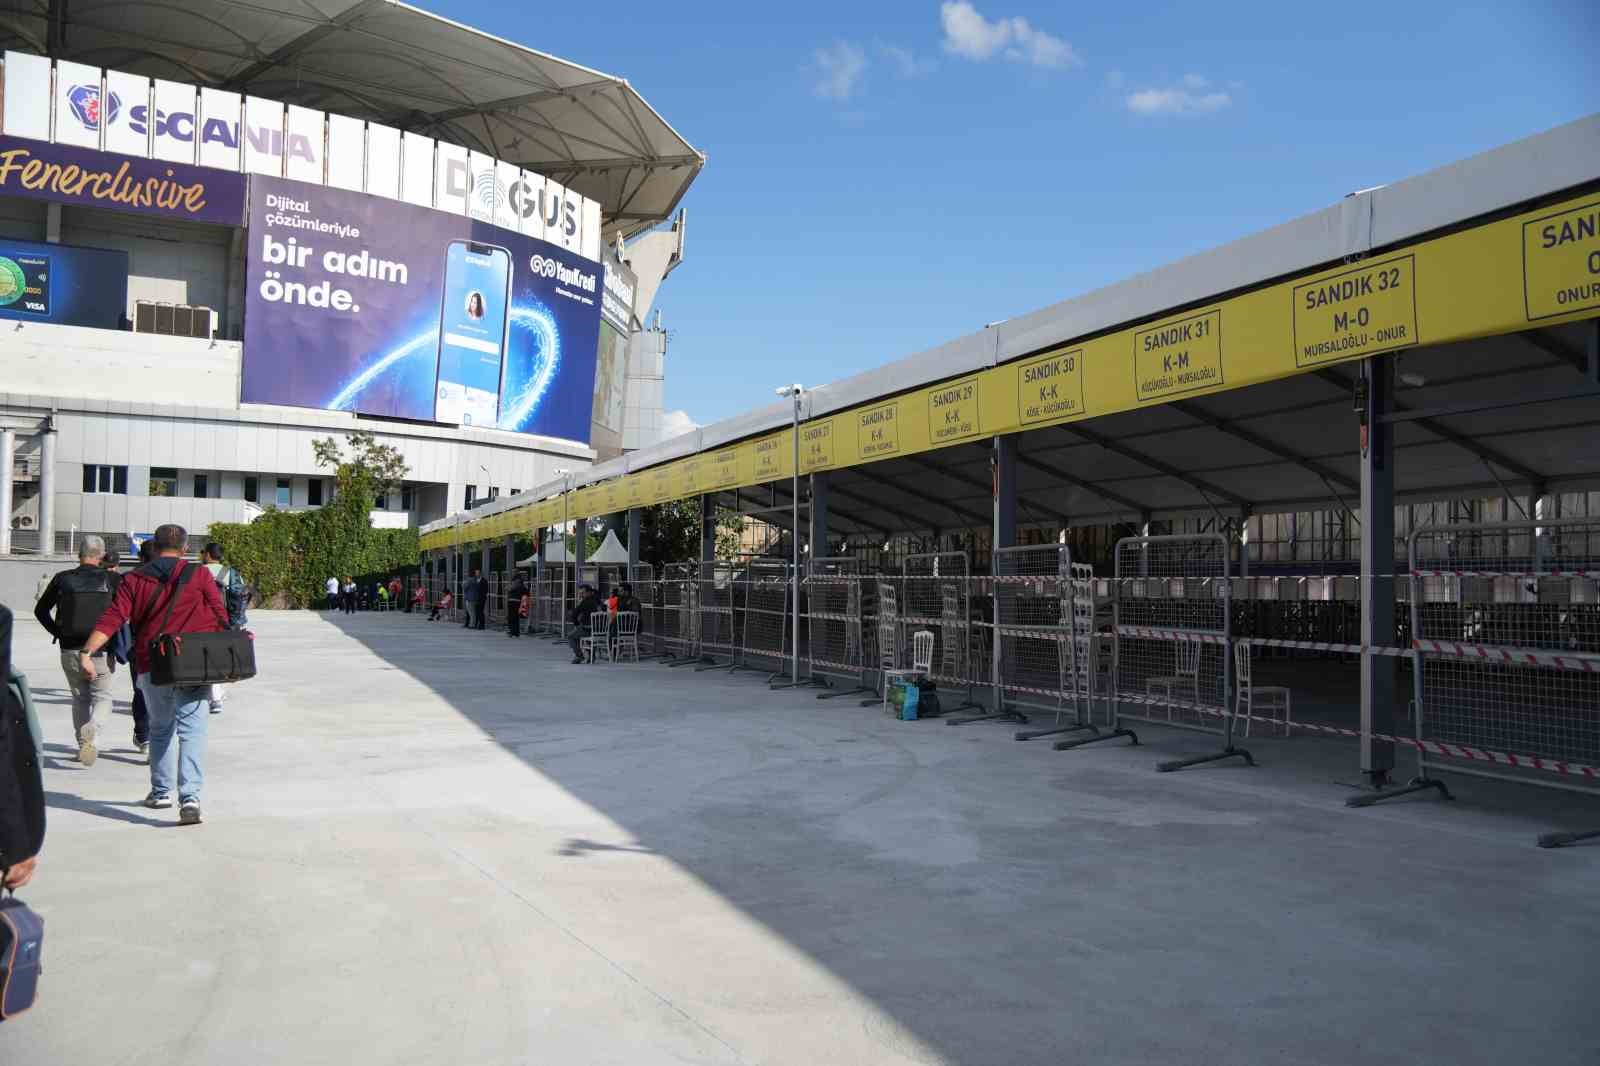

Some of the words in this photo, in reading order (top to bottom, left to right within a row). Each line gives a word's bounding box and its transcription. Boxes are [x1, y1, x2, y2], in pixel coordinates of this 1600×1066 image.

[129, 105, 315, 163] SCANIA
[0, 150, 206, 212] Fenerclusive
[266, 194, 310, 213] Dijital
[265, 212, 360, 239] çözümleriyle
[1541, 212, 1600, 249] SAN
[262, 234, 313, 268] bir
[323, 250, 408, 285] adım
[260, 271, 360, 313] önde.
[1306, 274, 1372, 310] SANDIK
[1378, 268, 1400, 291] 32
[25, 301, 46, 312] VISA
[1334, 307, 1369, 332] M-O
[1144, 324, 1192, 352] SANDIK
[1195, 319, 1209, 338] 31
[1304, 333, 1368, 358] MURSALOĞLU
[1376, 326, 1406, 343] ONUR
[1024, 360, 1061, 383] SANDIK
[1063, 357, 1074, 373] 30
[1163, 351, 1189, 372] K-M
[933, 391, 962, 408] SANDIK
[963, 385, 973, 400] 29
[1040, 384, 1058, 400] K-K
[945, 409, 960, 424] K-K
